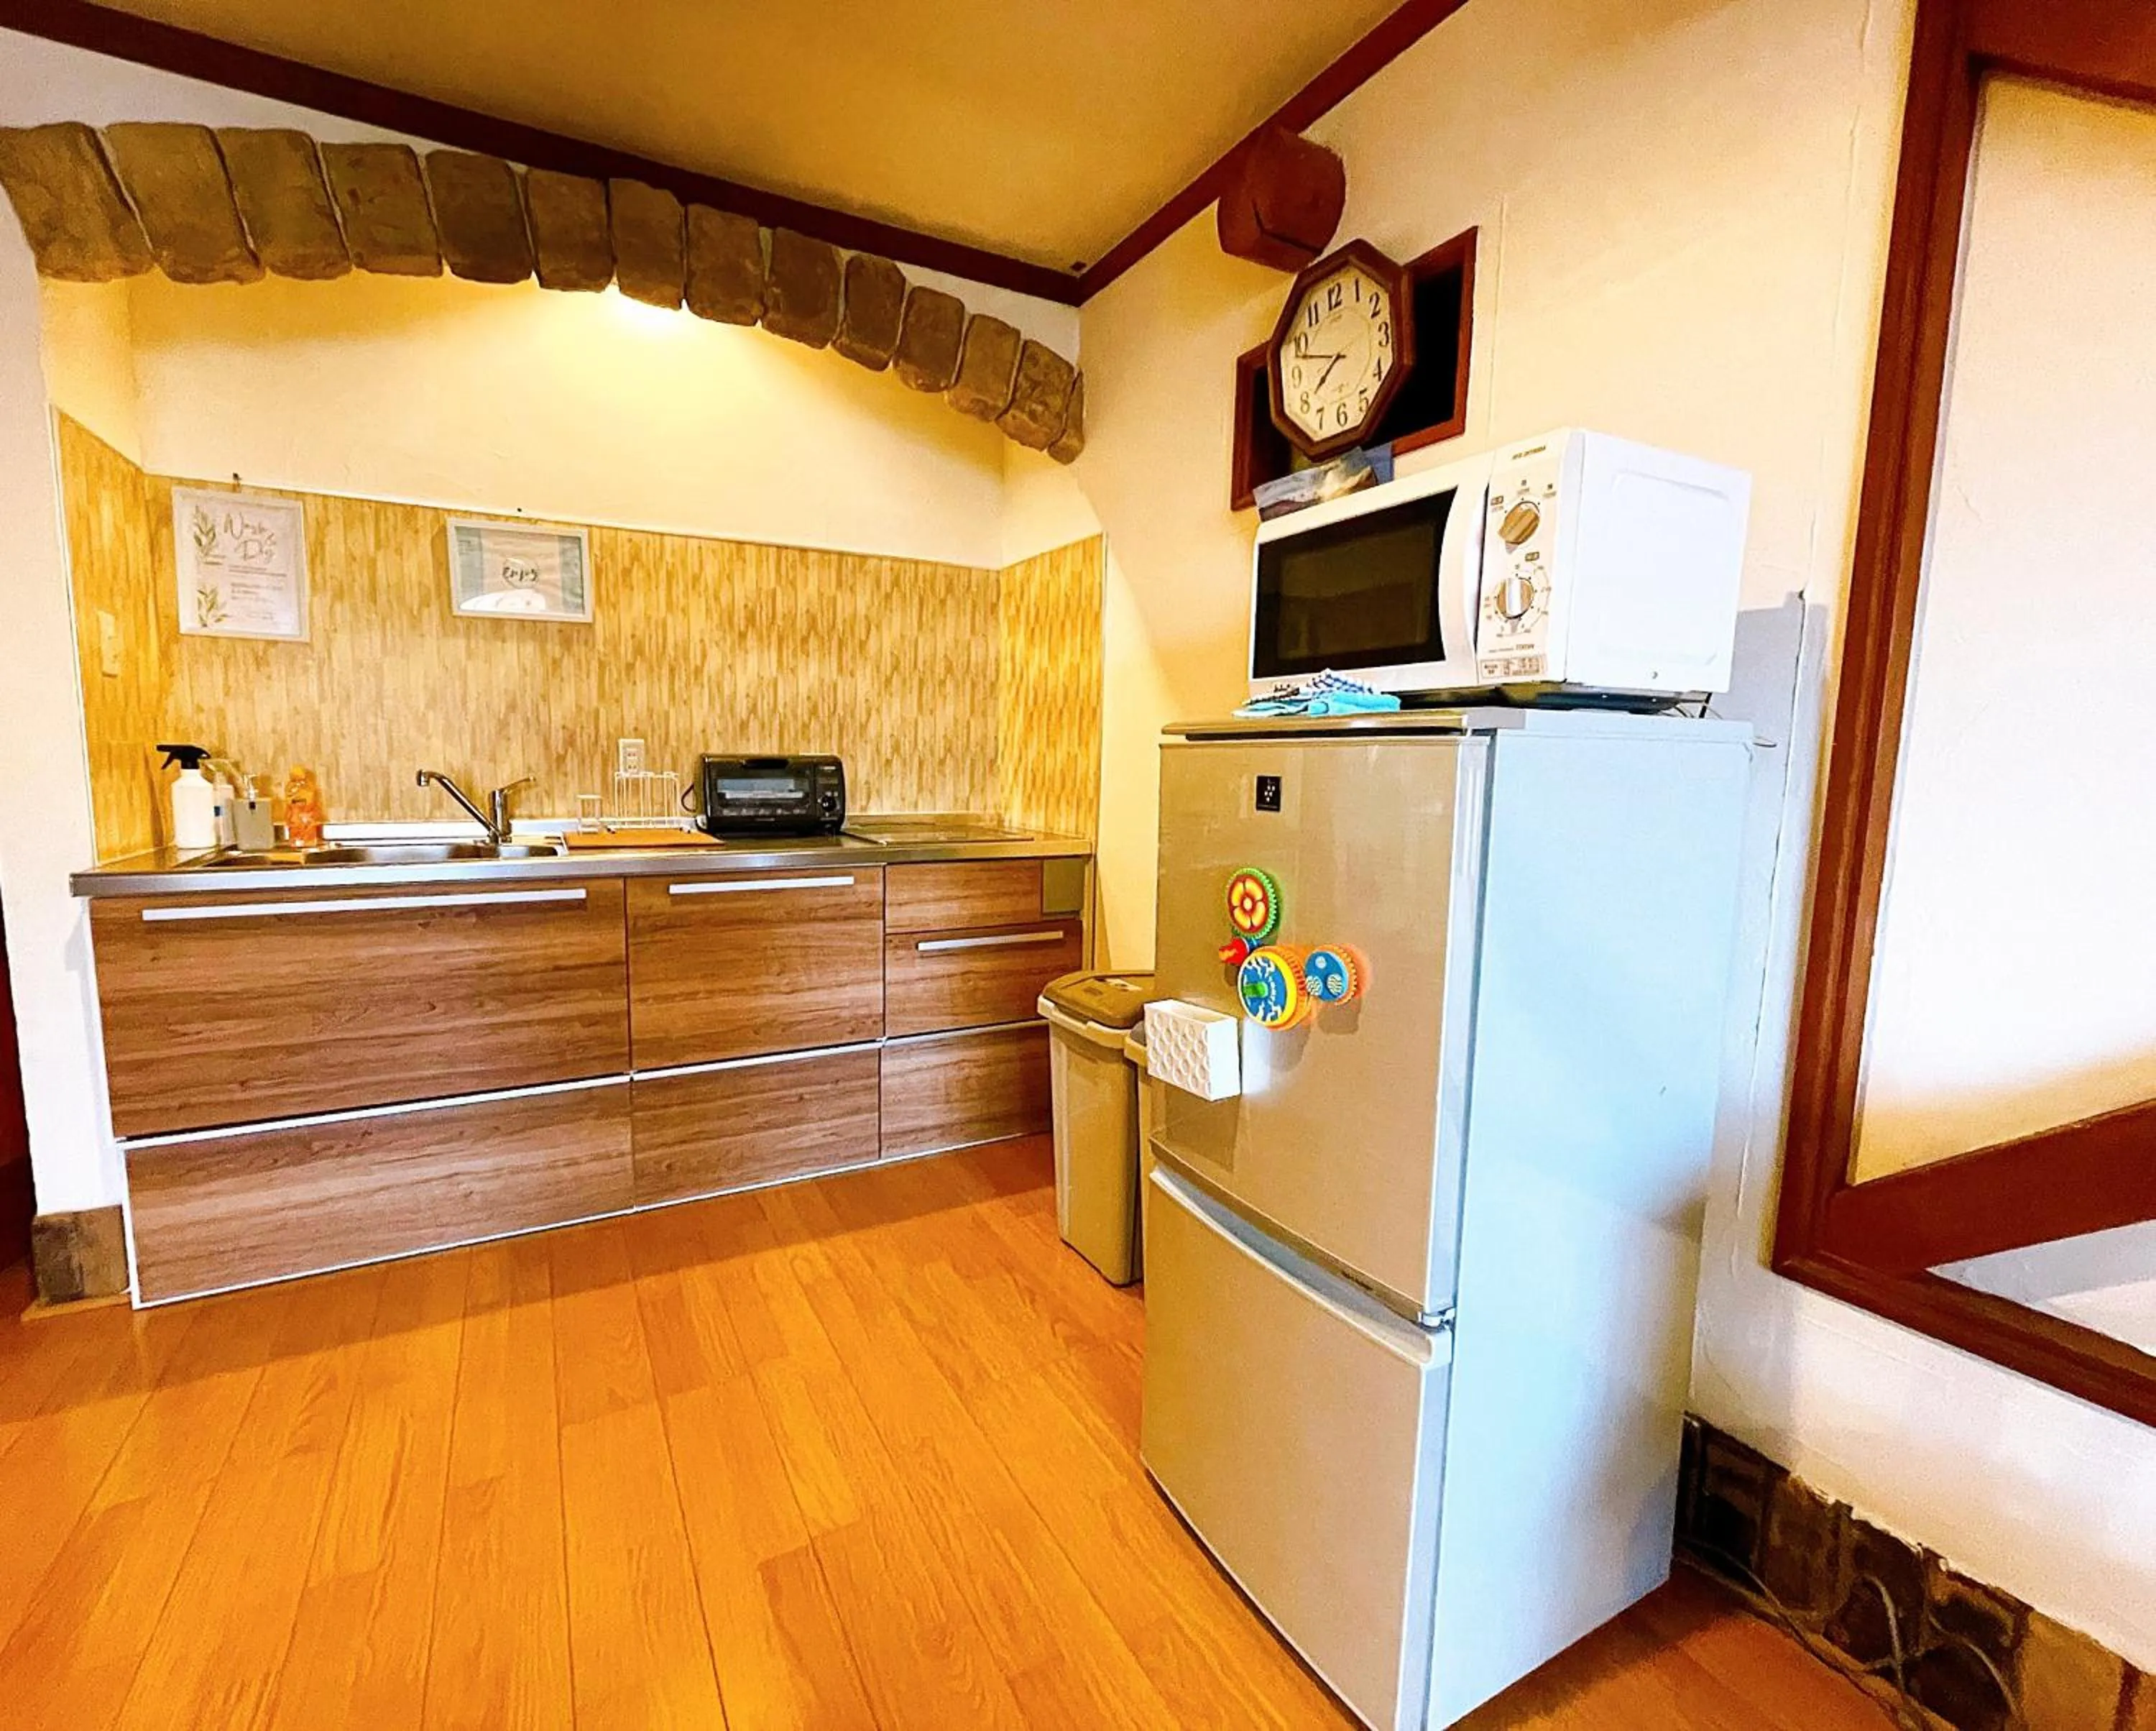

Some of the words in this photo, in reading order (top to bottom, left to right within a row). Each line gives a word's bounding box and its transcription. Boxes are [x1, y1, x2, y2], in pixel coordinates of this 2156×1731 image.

[1327, 283, 1342, 311] 12
[1355, 277, 1360, 303] 1
[1307, 302, 1319, 327] 11
[1369, 292, 1381, 318] 2
[1294, 332, 1309, 358] 10
[1378, 321, 1389, 347] 3
[1291, 366, 1302, 388] 9
[1373, 357, 1382, 381] 4
[1300, 391, 1310, 414] 8
[1358, 387, 1369, 413] 5
[1316, 407, 1325, 430] 7
[1336, 403, 1348, 427] 6
